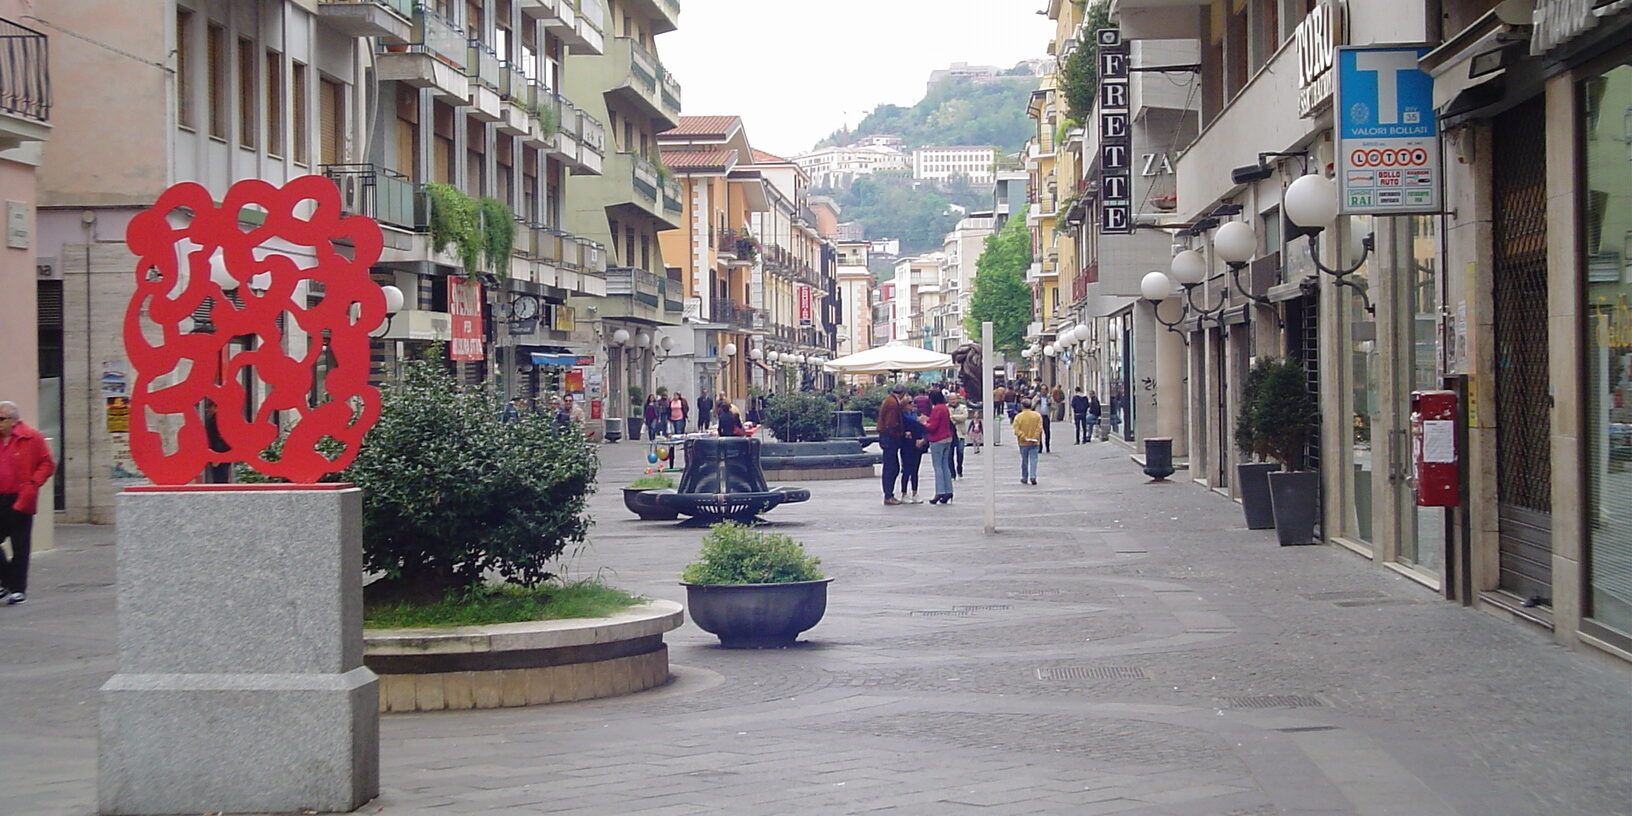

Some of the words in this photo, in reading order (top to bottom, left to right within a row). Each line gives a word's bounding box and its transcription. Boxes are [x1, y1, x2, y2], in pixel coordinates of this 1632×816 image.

[1295, 0, 1333, 89] TORO
[1356, 51, 1418, 124] T
[1103, 53, 1127, 229] FRETTE
[1352, 127, 1387, 136] VALORI
[1389, 126, 1427, 135] BOLLATI
[1353, 149, 1426, 165] LOTTO
[1351, 196, 1371, 206] RAI
